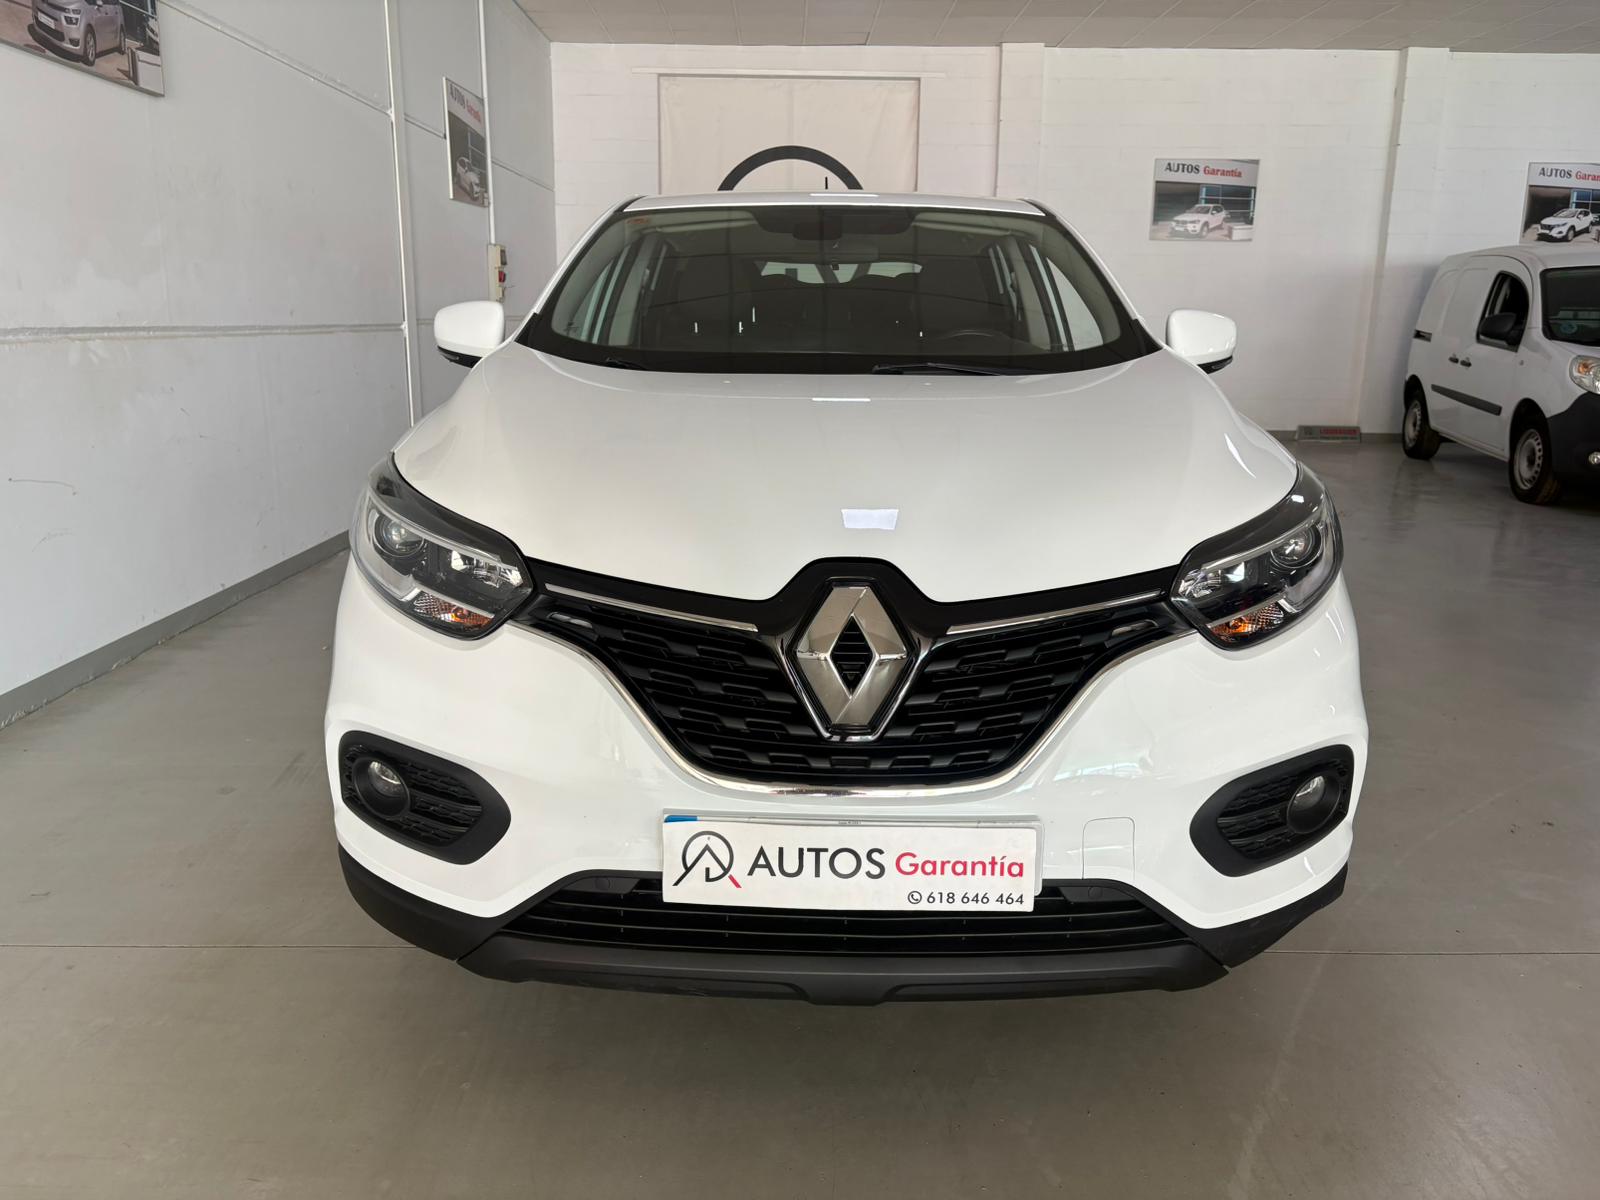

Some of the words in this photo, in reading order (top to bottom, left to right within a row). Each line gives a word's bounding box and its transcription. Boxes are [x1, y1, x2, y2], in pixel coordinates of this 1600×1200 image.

[1164, 162, 1200, 174] AUTOS
[1203, 165, 1242, 178] Garantía
[1538, 167, 1573, 179] AUTOS
[747, 845, 886, 880] AUTOS
[895, 852, 1024, 878] Garantía
[926, 891, 955, 904] 618
[961, 891, 990, 904] 646
[995, 892, 1024, 905] 464
